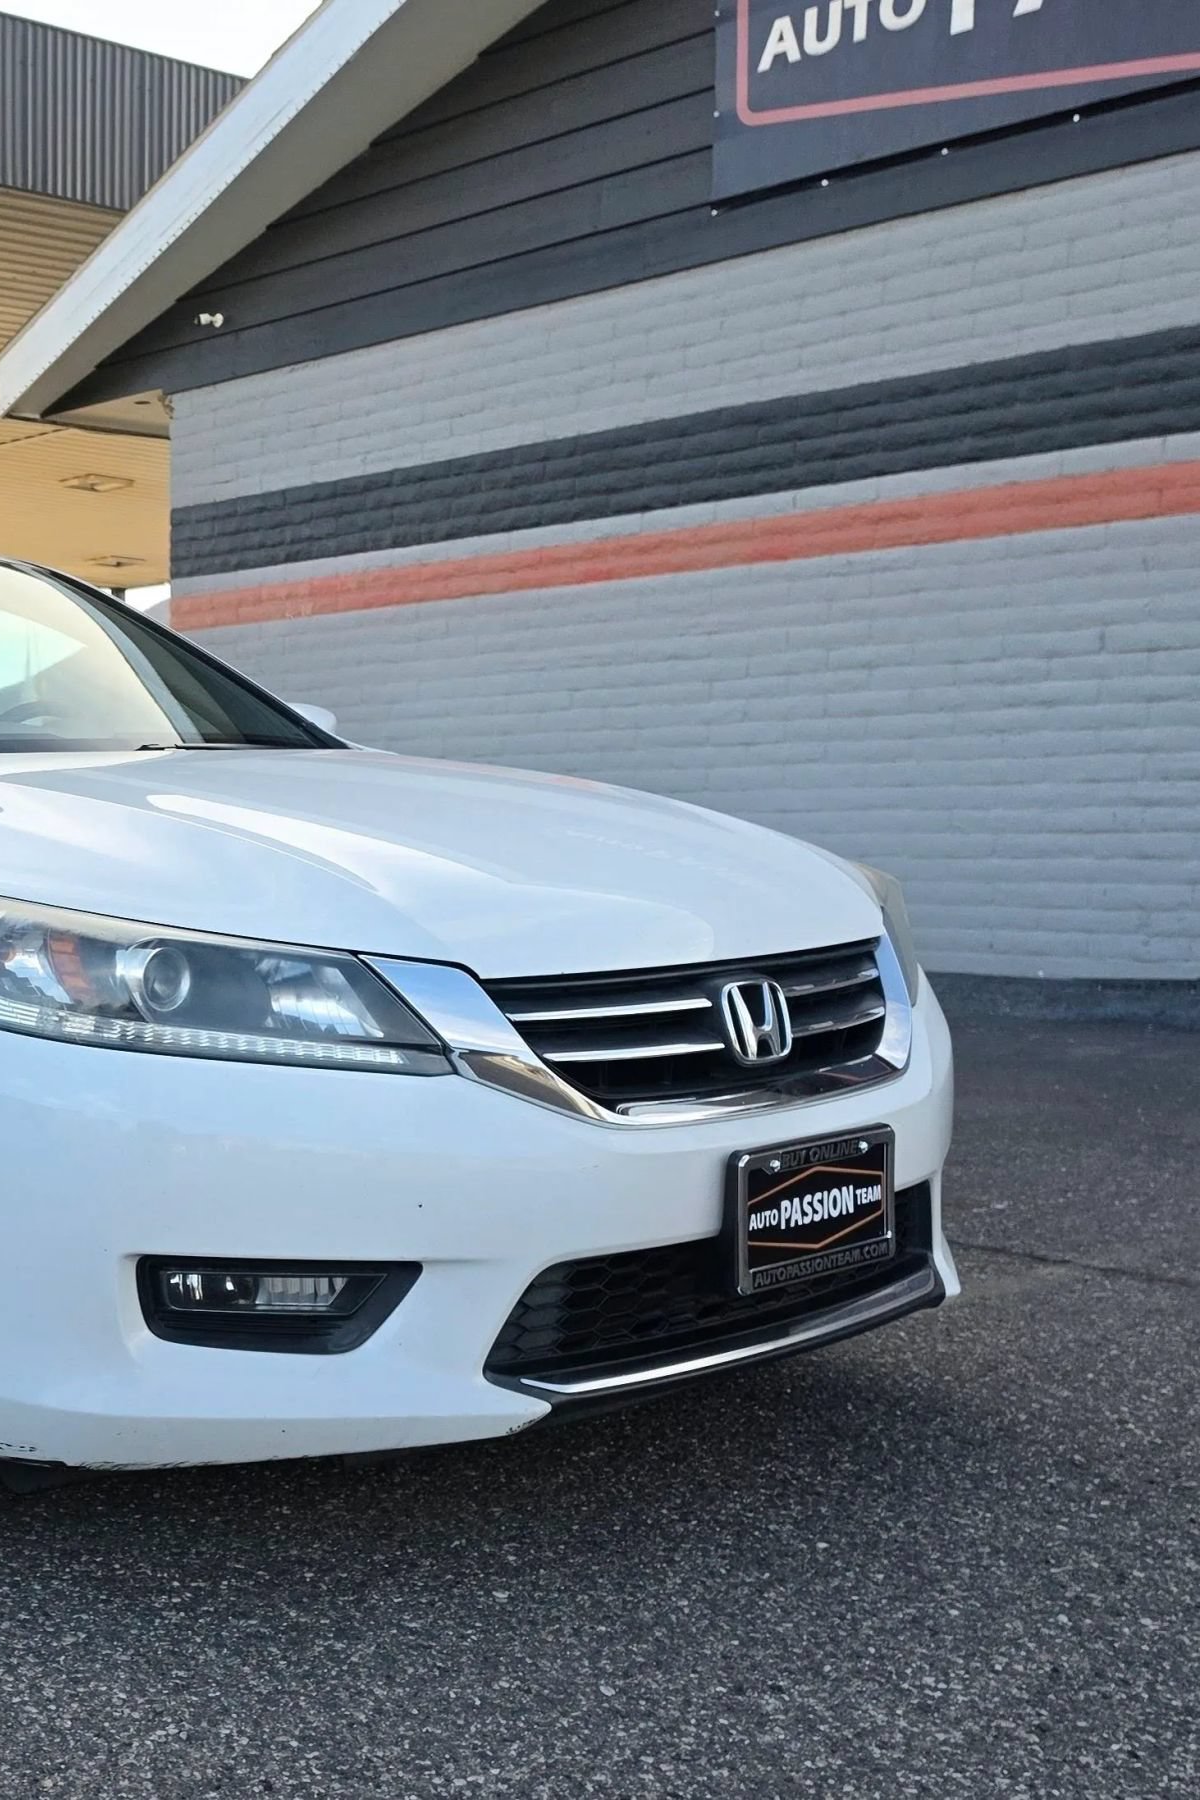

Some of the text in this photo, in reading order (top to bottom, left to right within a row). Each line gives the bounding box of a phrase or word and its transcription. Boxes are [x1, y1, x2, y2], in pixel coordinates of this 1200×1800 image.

[757, 0, 924, 73] AUTO
[783, 1139, 860, 1167] BUY ONLINE
[749, 1184, 882, 1231] AUTO PASSION TEAM
[754, 1240, 889, 1287] AUTOPASSIONTEAM.COM
